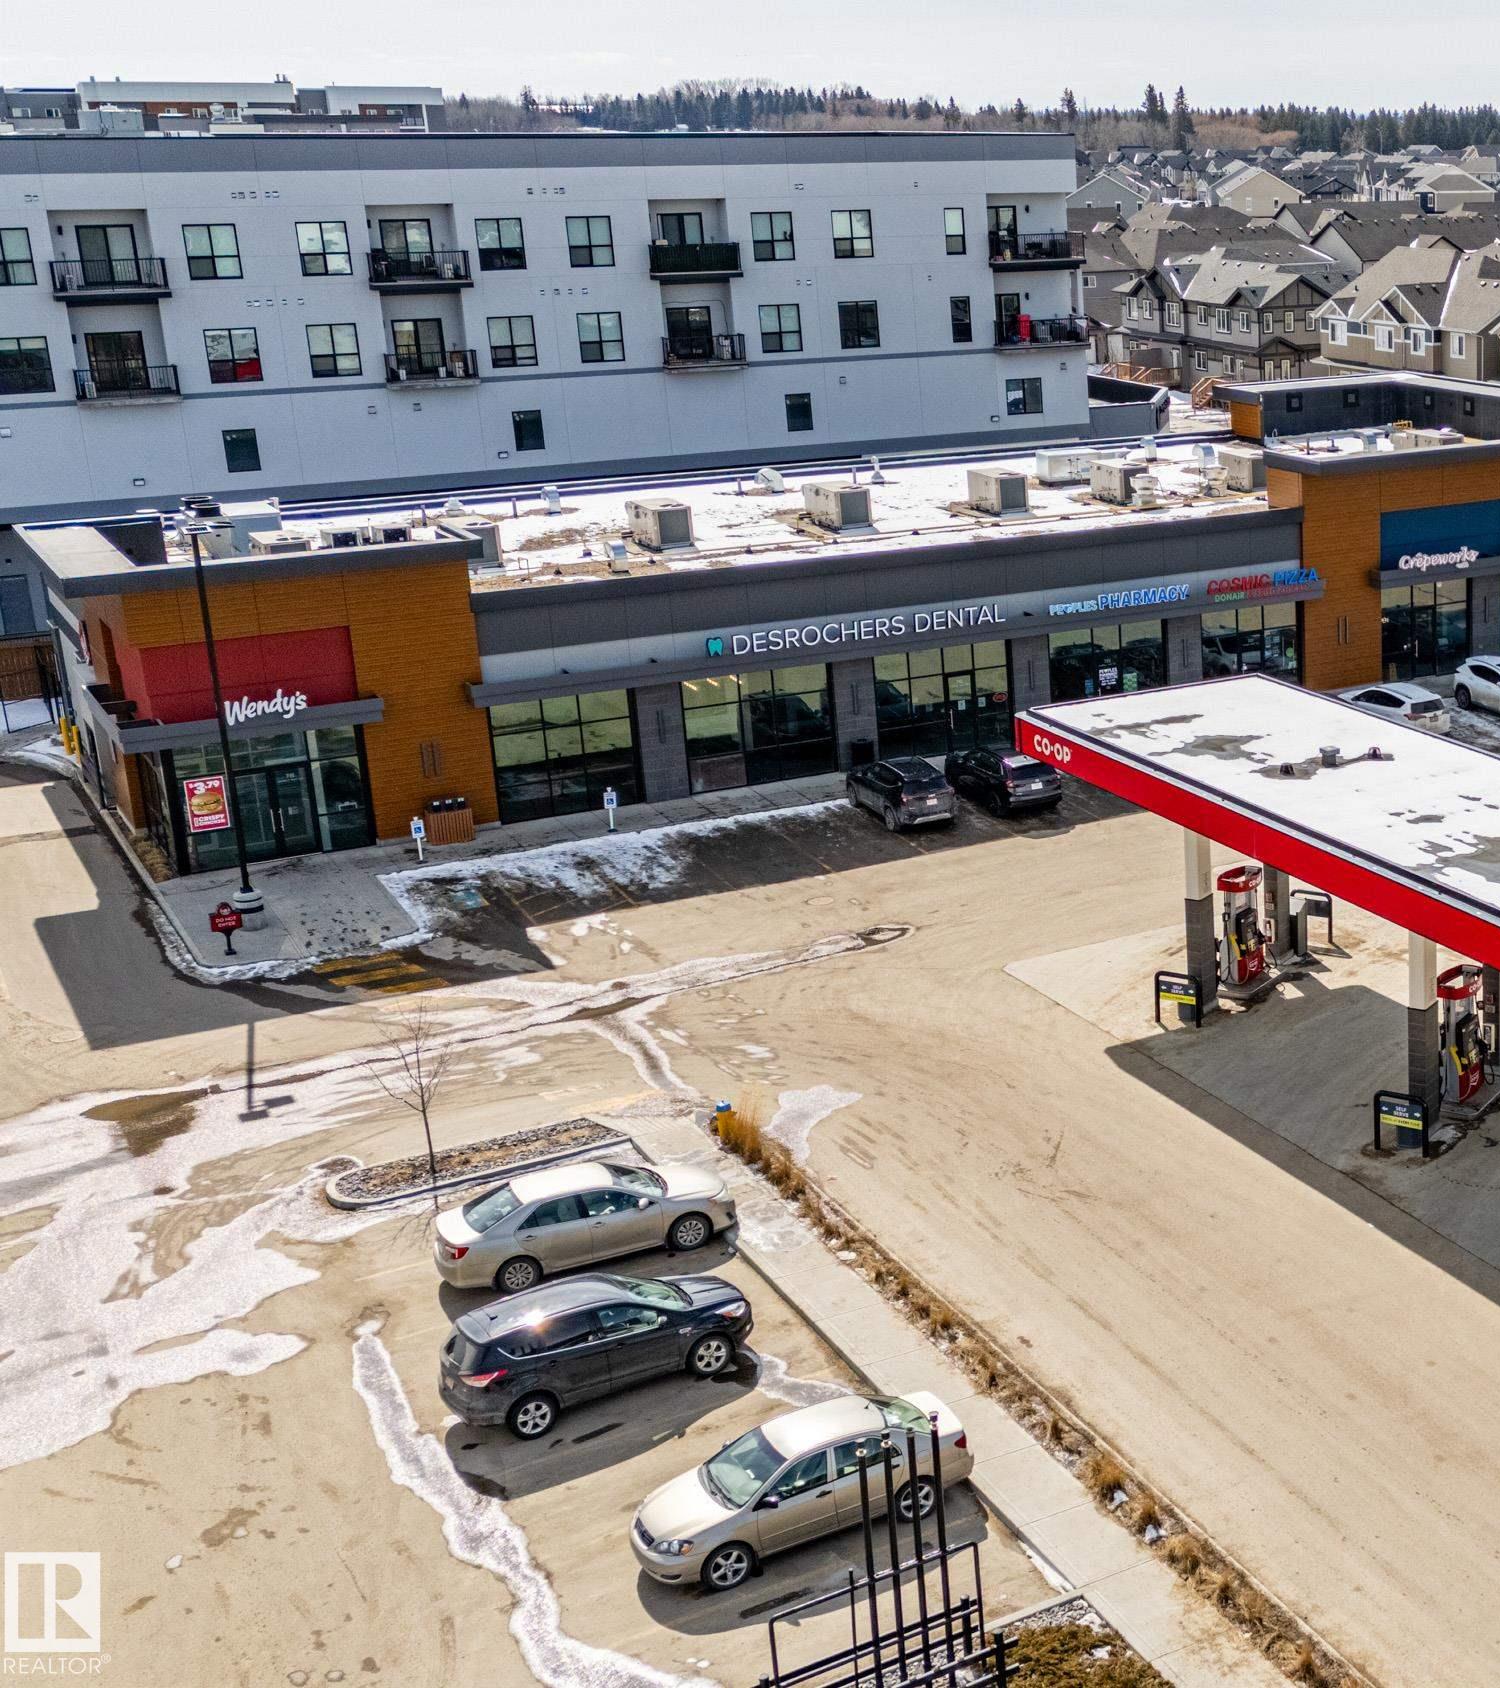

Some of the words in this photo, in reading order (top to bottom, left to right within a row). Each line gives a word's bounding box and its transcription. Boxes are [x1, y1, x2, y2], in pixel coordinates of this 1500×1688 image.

[1399, 546, 1479, 572] Crêpeworks
[1207, 574, 1272, 595] COSMIC
[1273, 568, 1318, 586] PIZZA
[1098, 584, 1190, 610] PHARMACY
[1214, 592, 1245, 602] DONAIR
[732, 615, 905, 655] DESROCHERS
[914, 604, 1006, 633] DENTAL
[224, 689, 307, 726] Wendy's
